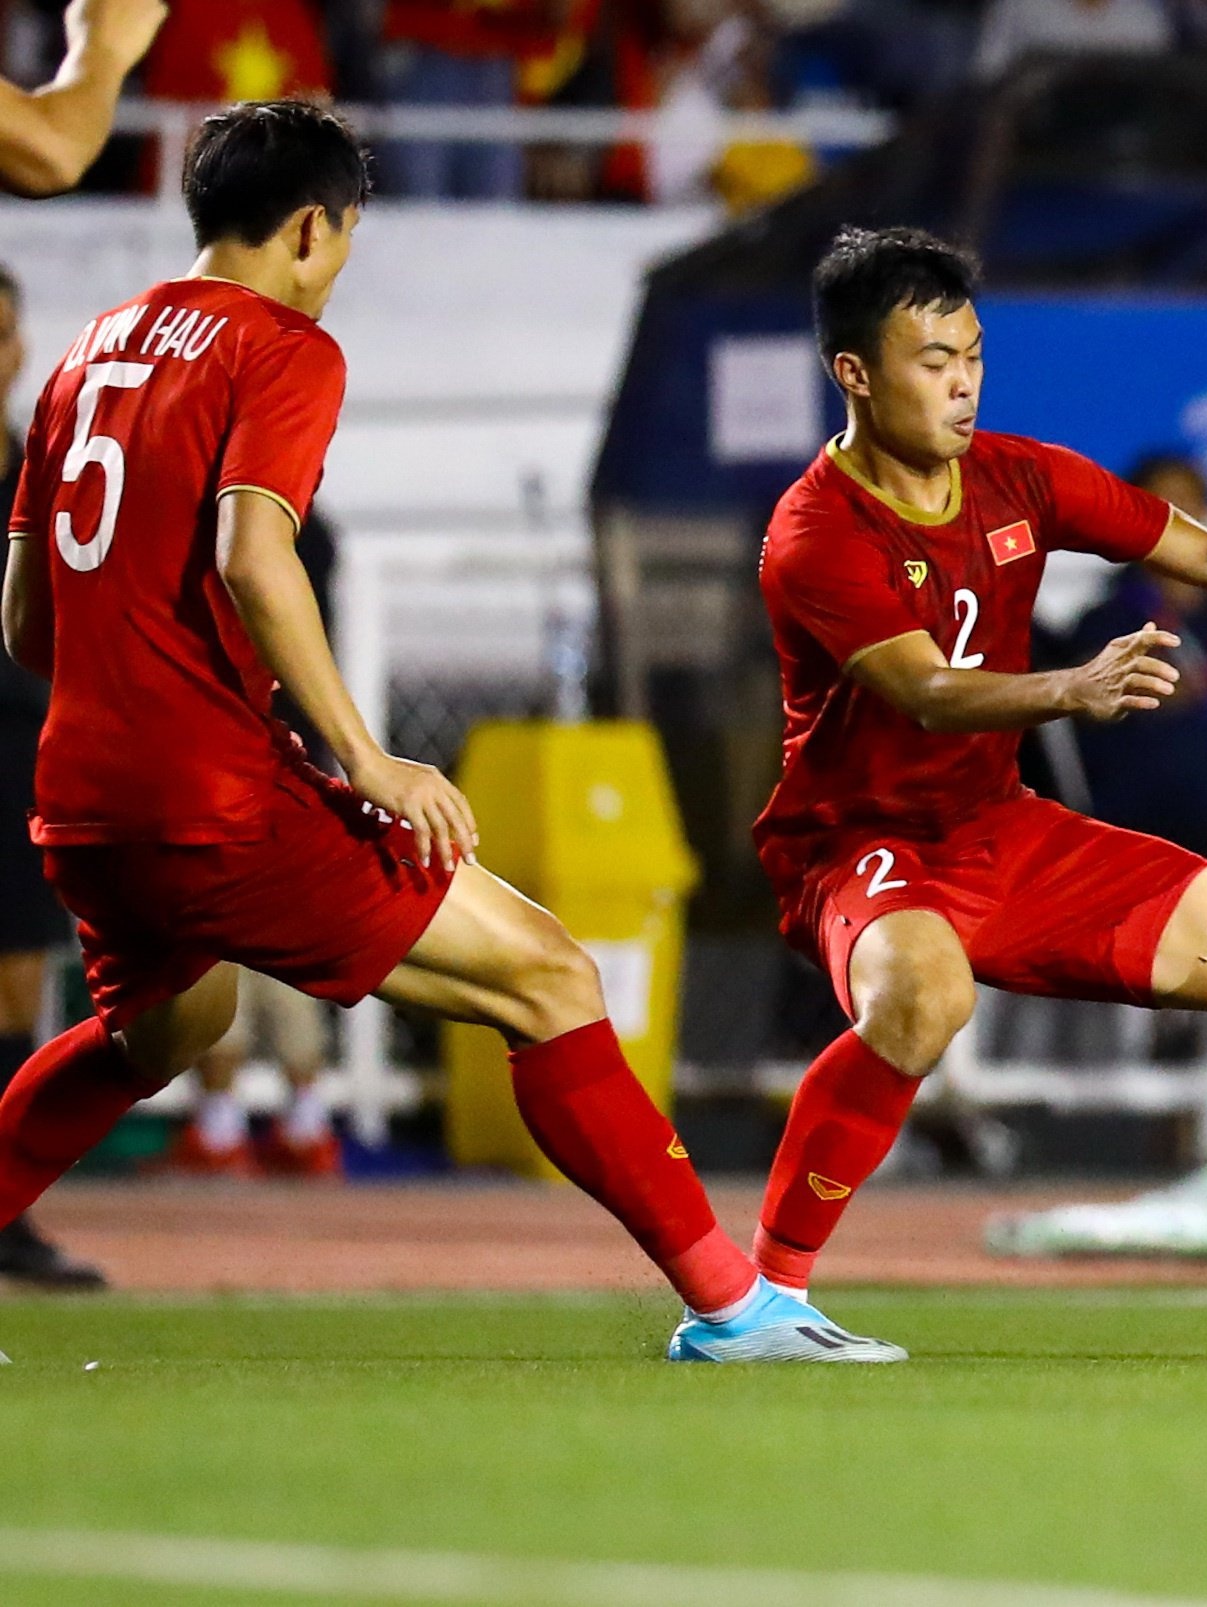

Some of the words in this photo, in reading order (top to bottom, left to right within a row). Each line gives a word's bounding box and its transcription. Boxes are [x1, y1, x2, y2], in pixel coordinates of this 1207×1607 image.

[140, 305, 229, 361] HAU
[55, 361, 154, 572] 5
[949, 588, 985, 669] 2
[856, 849, 909, 899] 2
